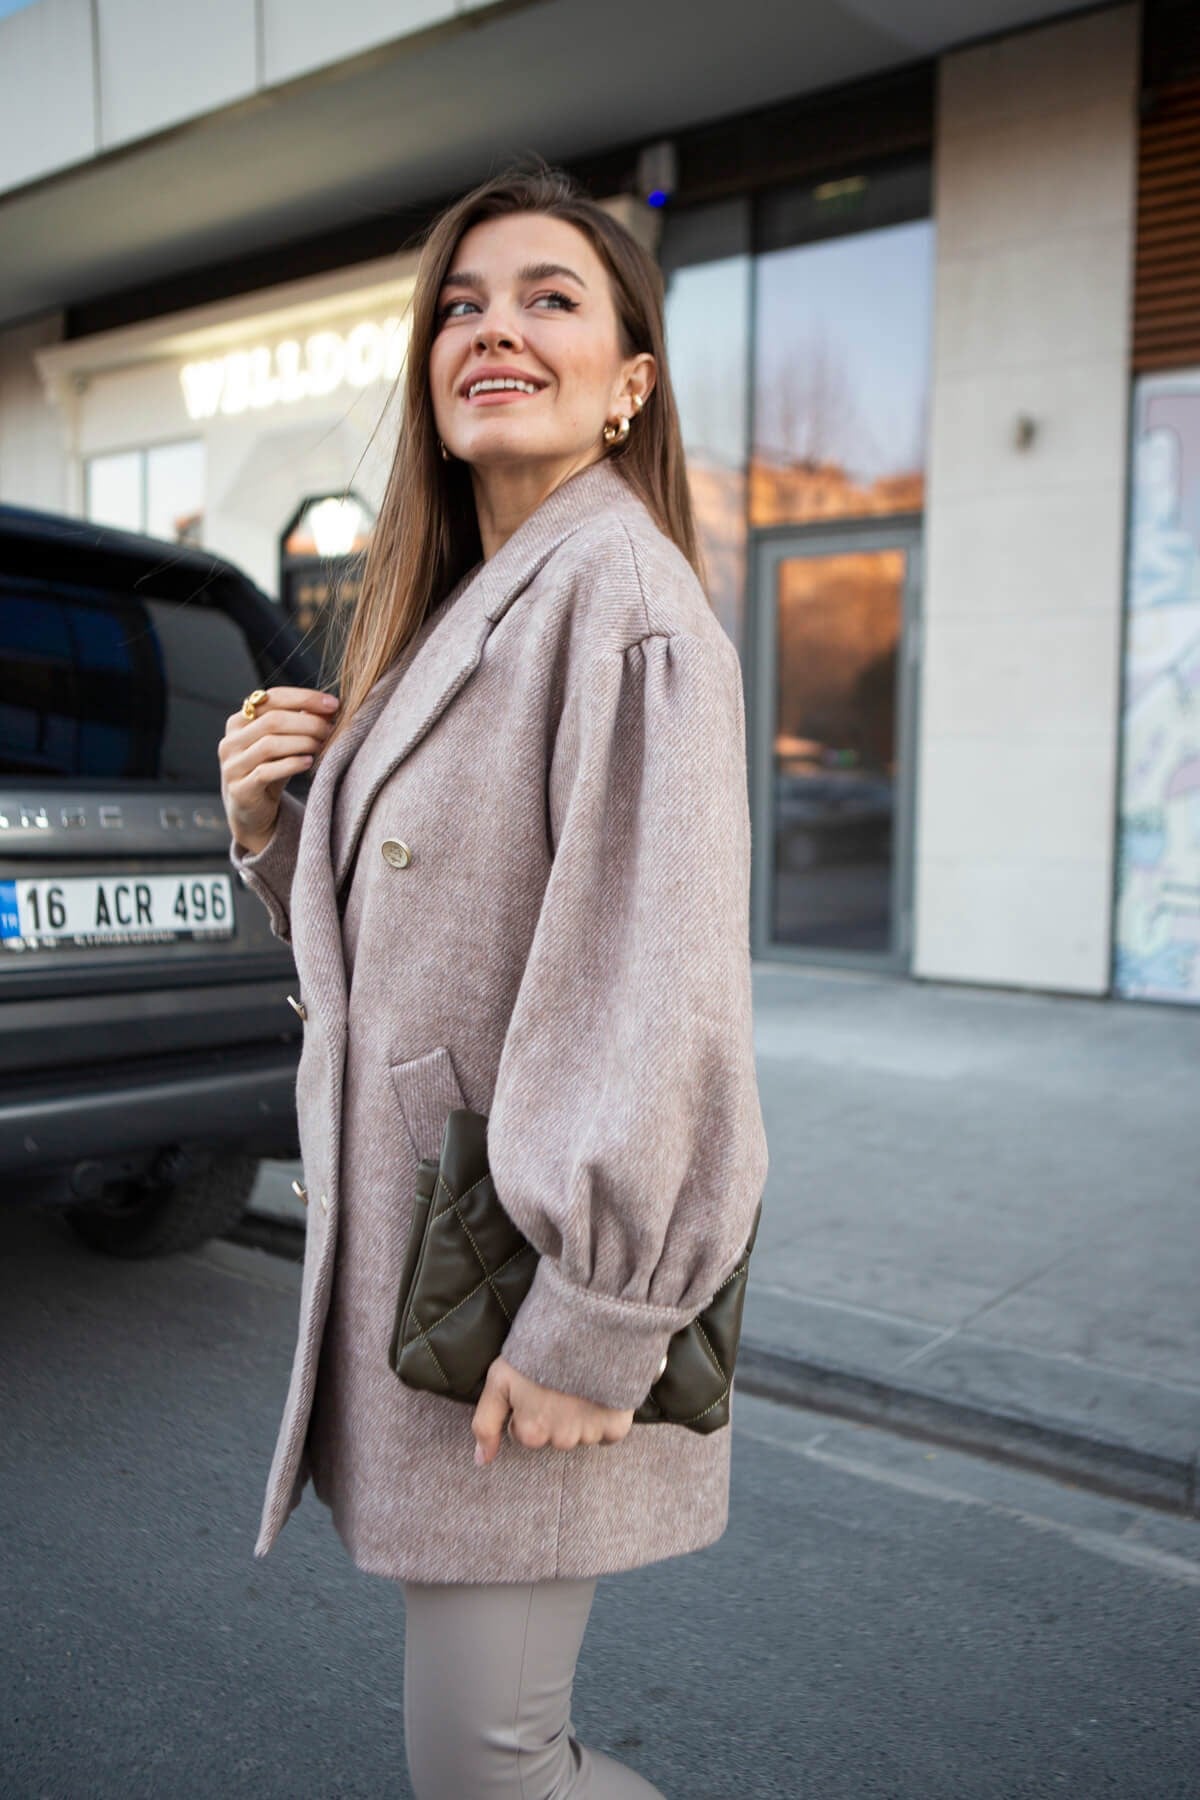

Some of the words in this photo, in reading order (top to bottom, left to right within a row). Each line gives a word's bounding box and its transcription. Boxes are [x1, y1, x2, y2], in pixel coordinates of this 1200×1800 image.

[27, 886, 67, 930] 16
[96, 884, 153, 927] ACR
[174, 882, 227, 922] 496
